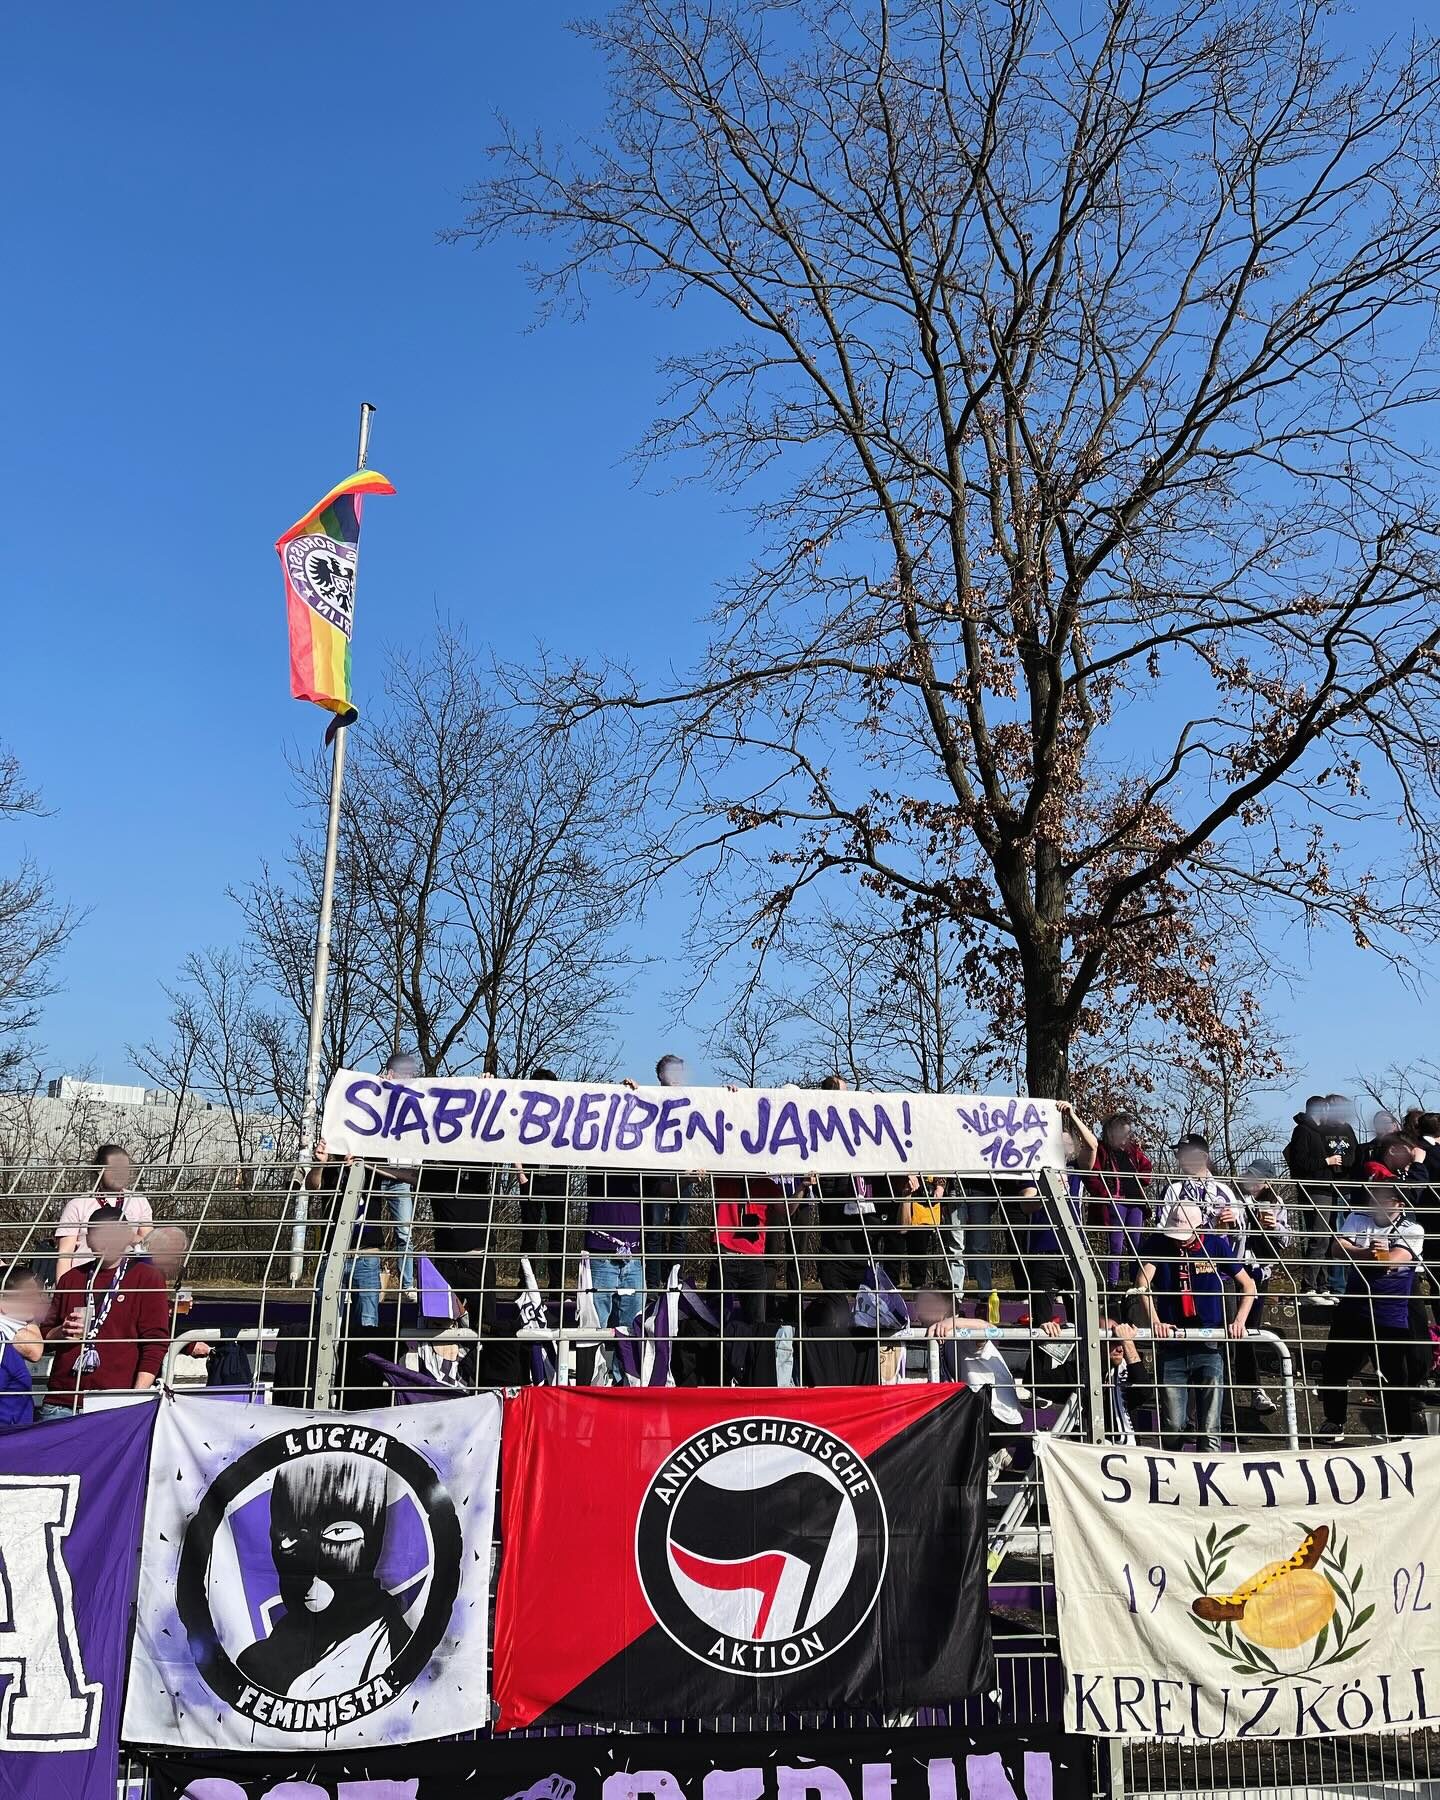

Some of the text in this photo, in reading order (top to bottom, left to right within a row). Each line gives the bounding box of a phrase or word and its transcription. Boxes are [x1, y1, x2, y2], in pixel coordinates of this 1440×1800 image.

[740, 1097, 914, 1162] JAMM!
[285, 1426, 389, 1459] LUCHA
[653, 1422, 871, 1506] ANTIFASCHISTISCHE
[1099, 1451, 1415, 1508] SEKTION
[1122, 1562, 1167, 1614] 19
[707, 1631, 825, 1669] AKTION
[235, 1676, 394, 1729] FEMINISTA
